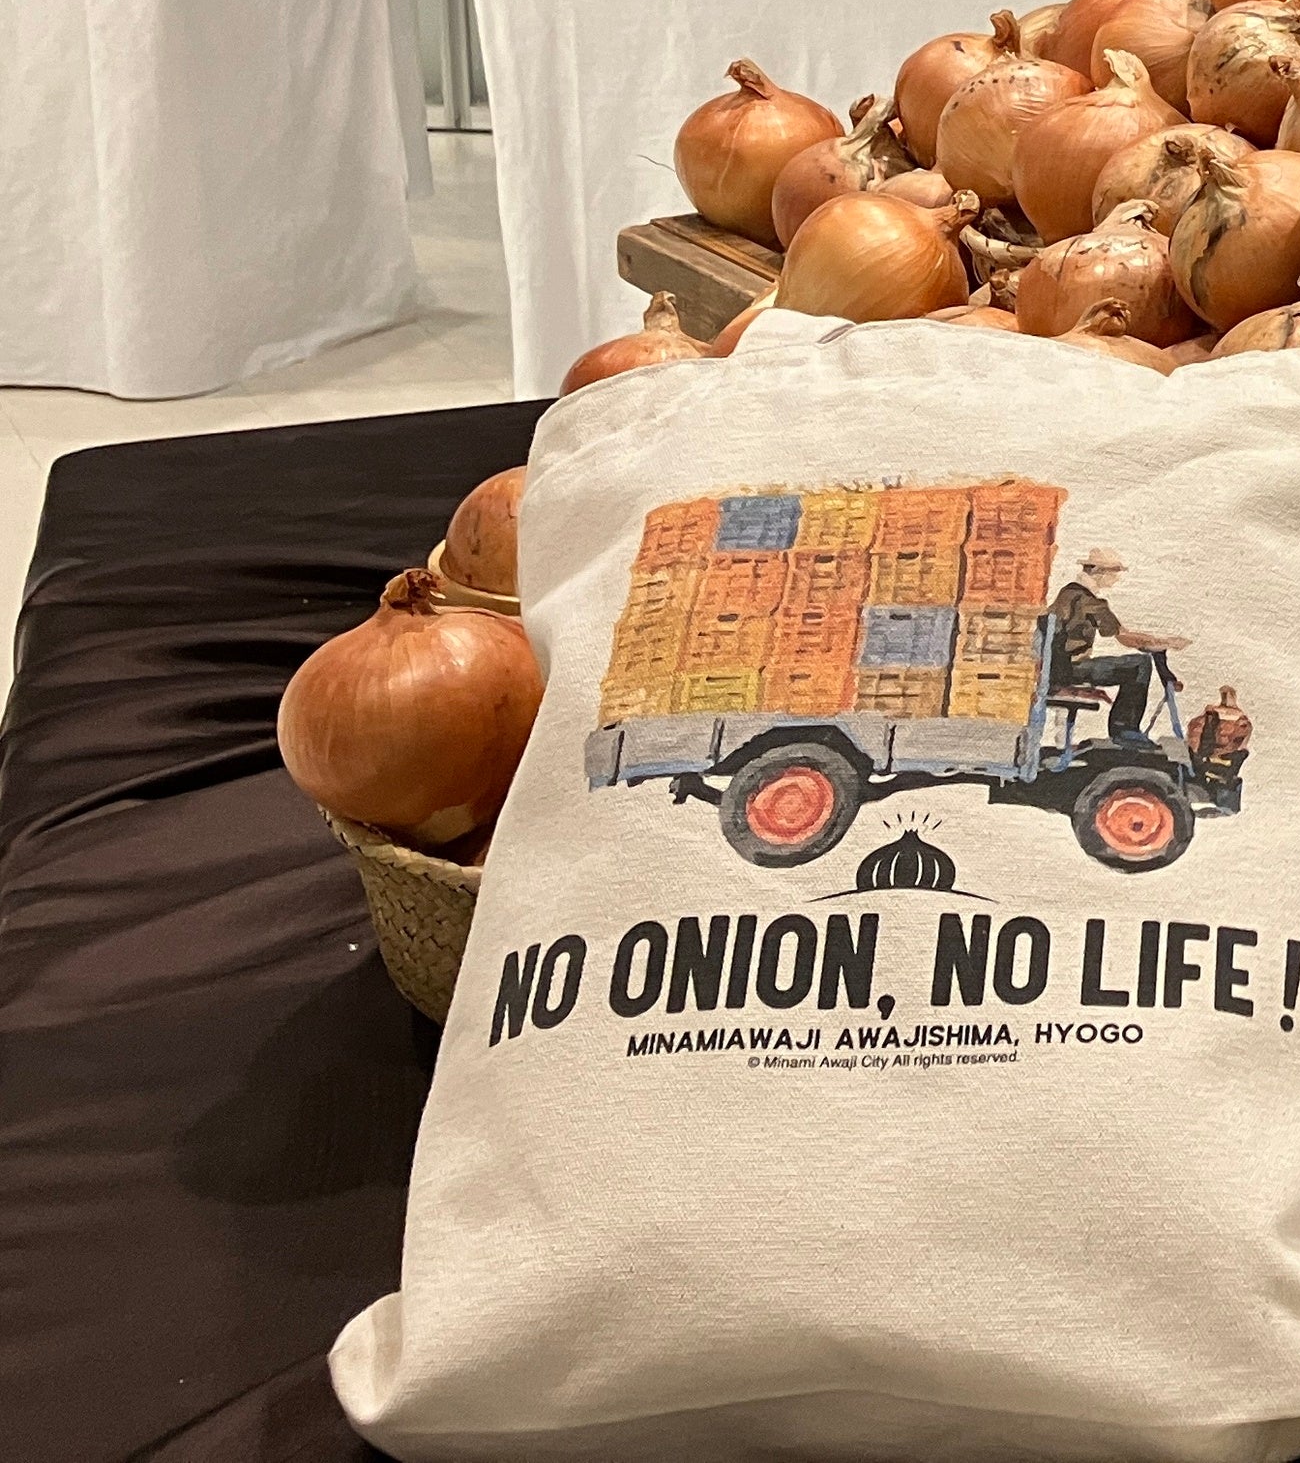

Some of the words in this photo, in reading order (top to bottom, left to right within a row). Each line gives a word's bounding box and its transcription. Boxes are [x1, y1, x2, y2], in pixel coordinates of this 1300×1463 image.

[489, 934, 586, 1048] NO
[609, 913, 898, 1019] ONION,
[931, 913, 1050, 1009] NO
[626, 1027, 821, 1057] MINAMIAWAJI
[834, 1023, 1020, 1052] AWAJISHIMA,
[1034, 1023, 1144, 1045] HYOGO
[763, 1053, 815, 1070] Minami
[818, 1054, 858, 1072] Awaji
[861, 1053, 889, 1071] City
[892, 1053, 911, 1068] All
[913, 1053, 952, 1070] rights
[956, 1050, 1020, 1067] reserved.
